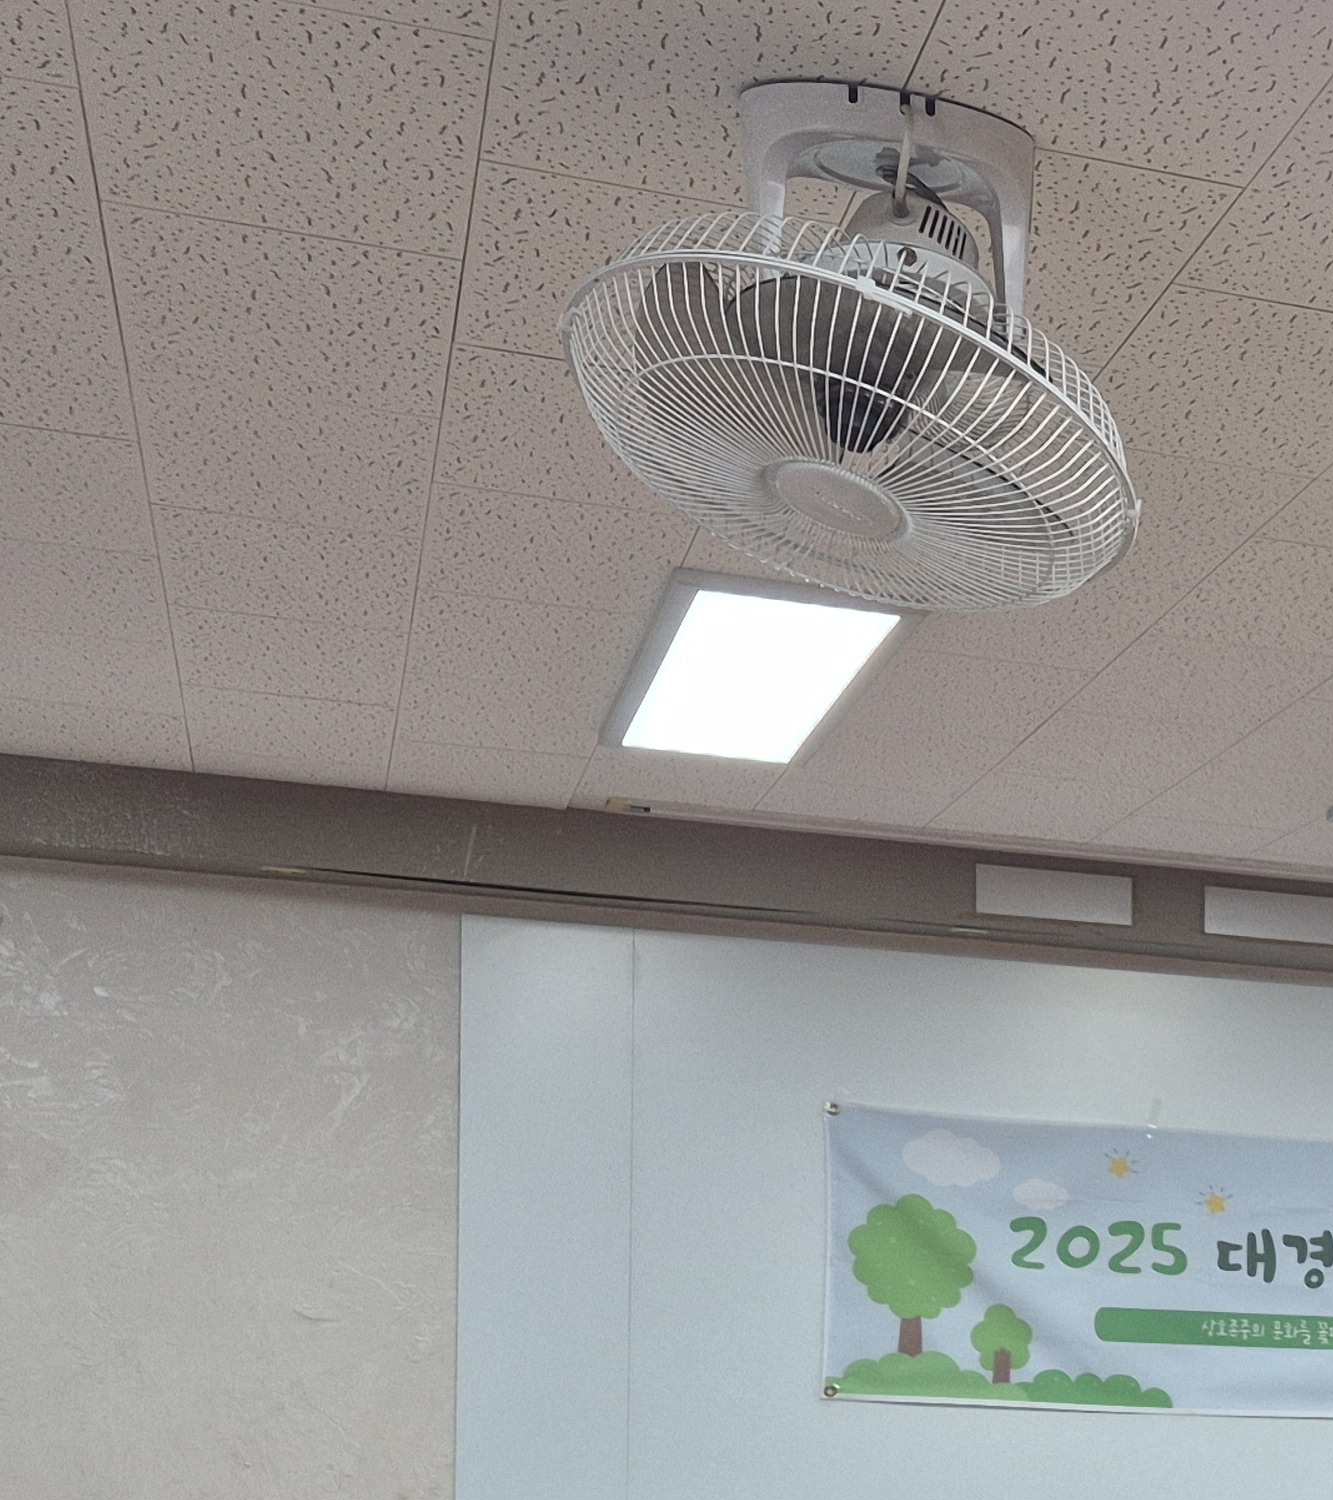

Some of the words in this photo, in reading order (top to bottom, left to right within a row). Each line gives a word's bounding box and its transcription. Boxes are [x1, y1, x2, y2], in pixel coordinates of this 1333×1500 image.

[1009, 1216, 1188, 1276] 2025
[1201, 1318, 1265, 1341] 상호존중의
[1272, 1319, 1312, 1345] 문화를
